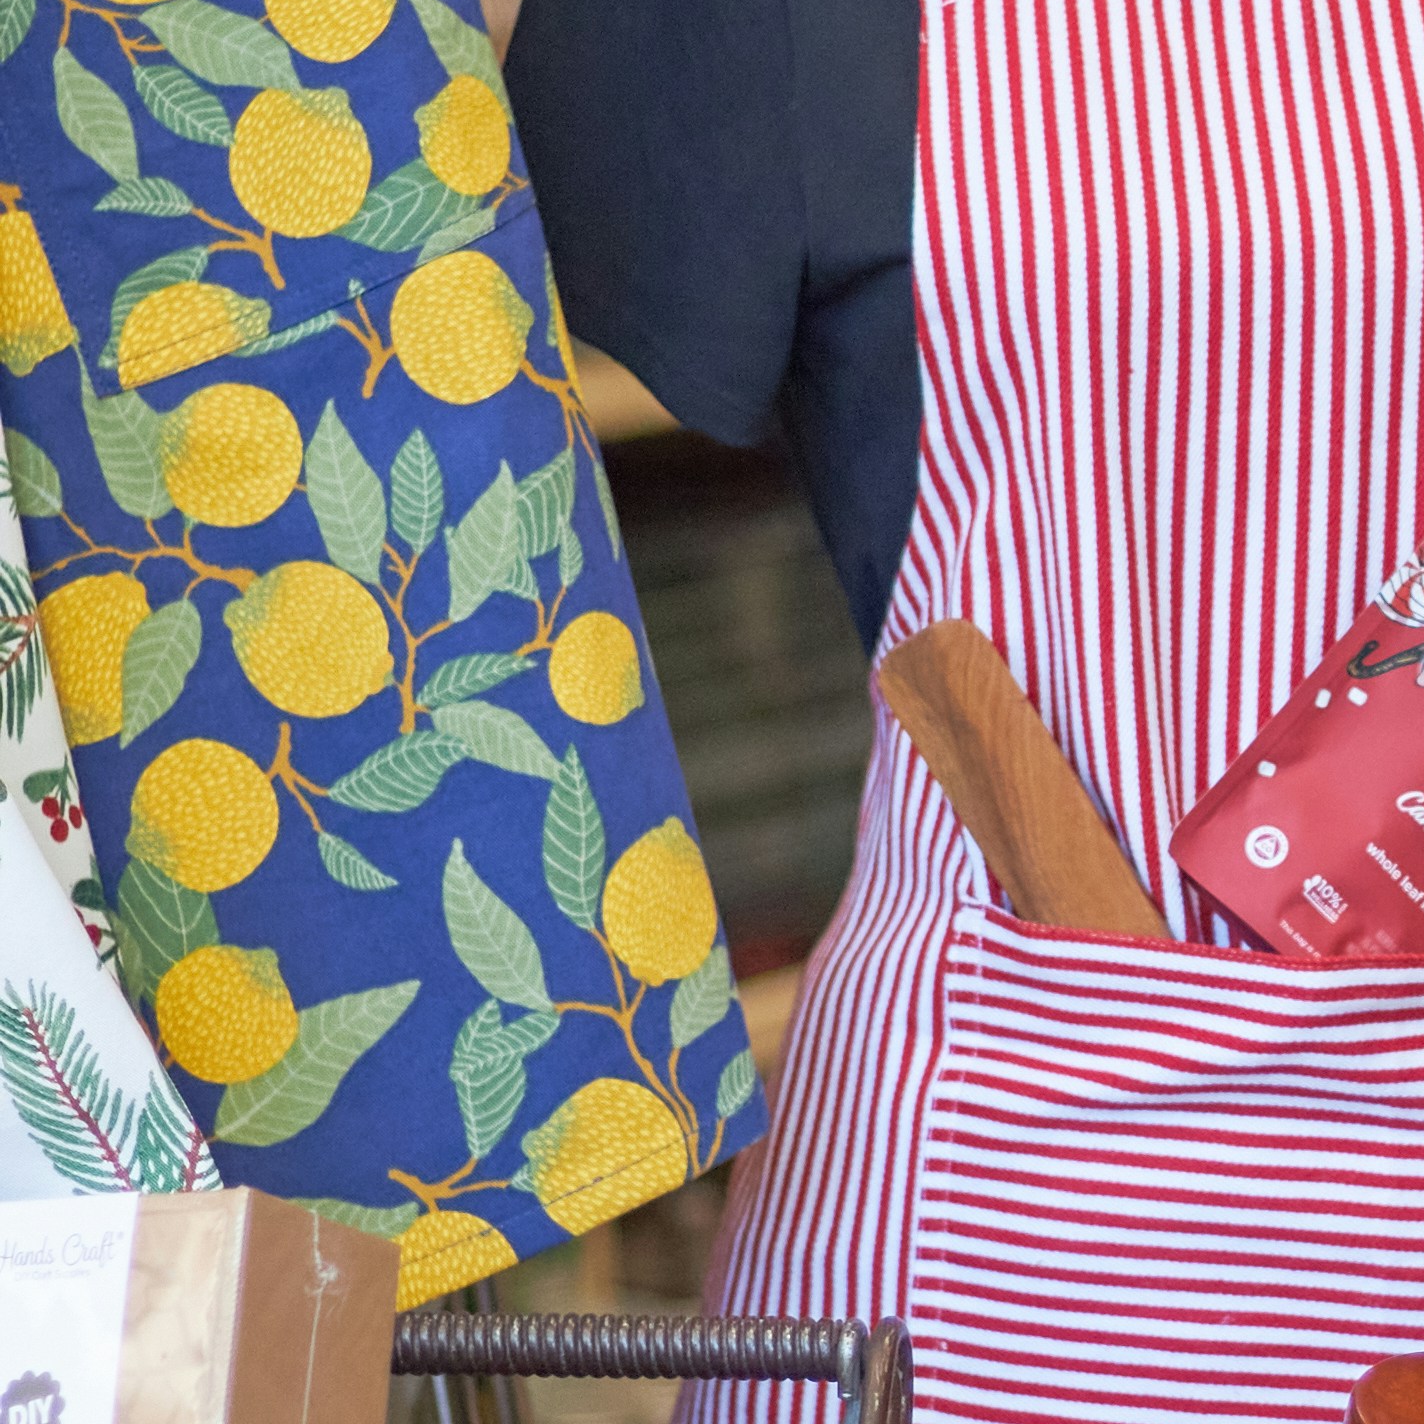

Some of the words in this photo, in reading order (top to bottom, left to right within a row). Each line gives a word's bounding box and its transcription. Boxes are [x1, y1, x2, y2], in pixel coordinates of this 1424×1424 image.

[1366, 841, 1402, 880] whole
[0, 1235, 54, 1273] Hands
[62, 1230, 115, 1268] Craft
